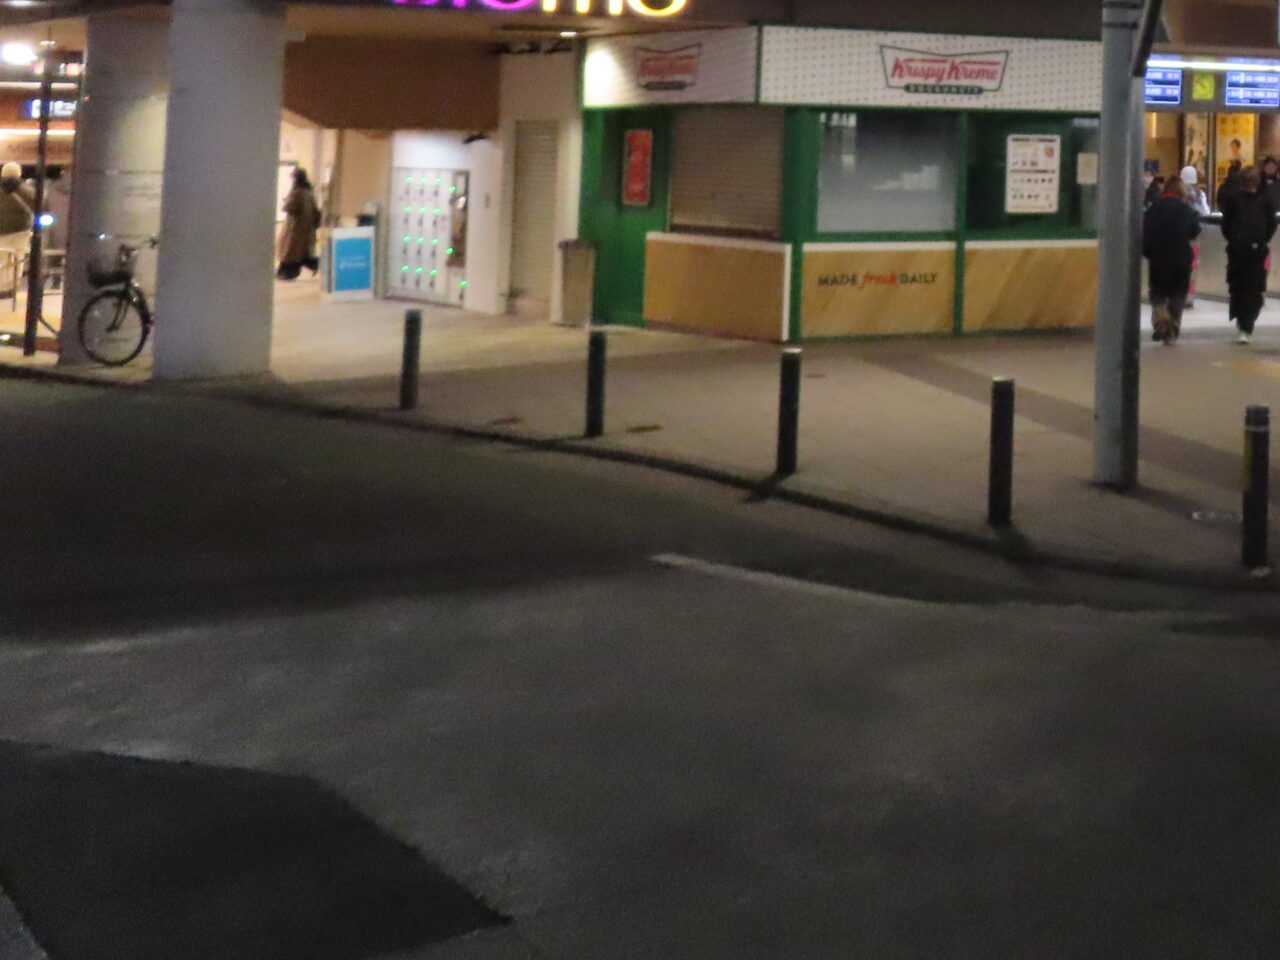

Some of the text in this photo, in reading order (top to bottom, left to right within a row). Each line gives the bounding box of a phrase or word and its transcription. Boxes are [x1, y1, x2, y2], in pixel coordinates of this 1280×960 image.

[891, 57, 1002, 84] Krispy Kreme
[818, 273, 858, 286] MADE
[899, 271, 938, 284] DAILY
